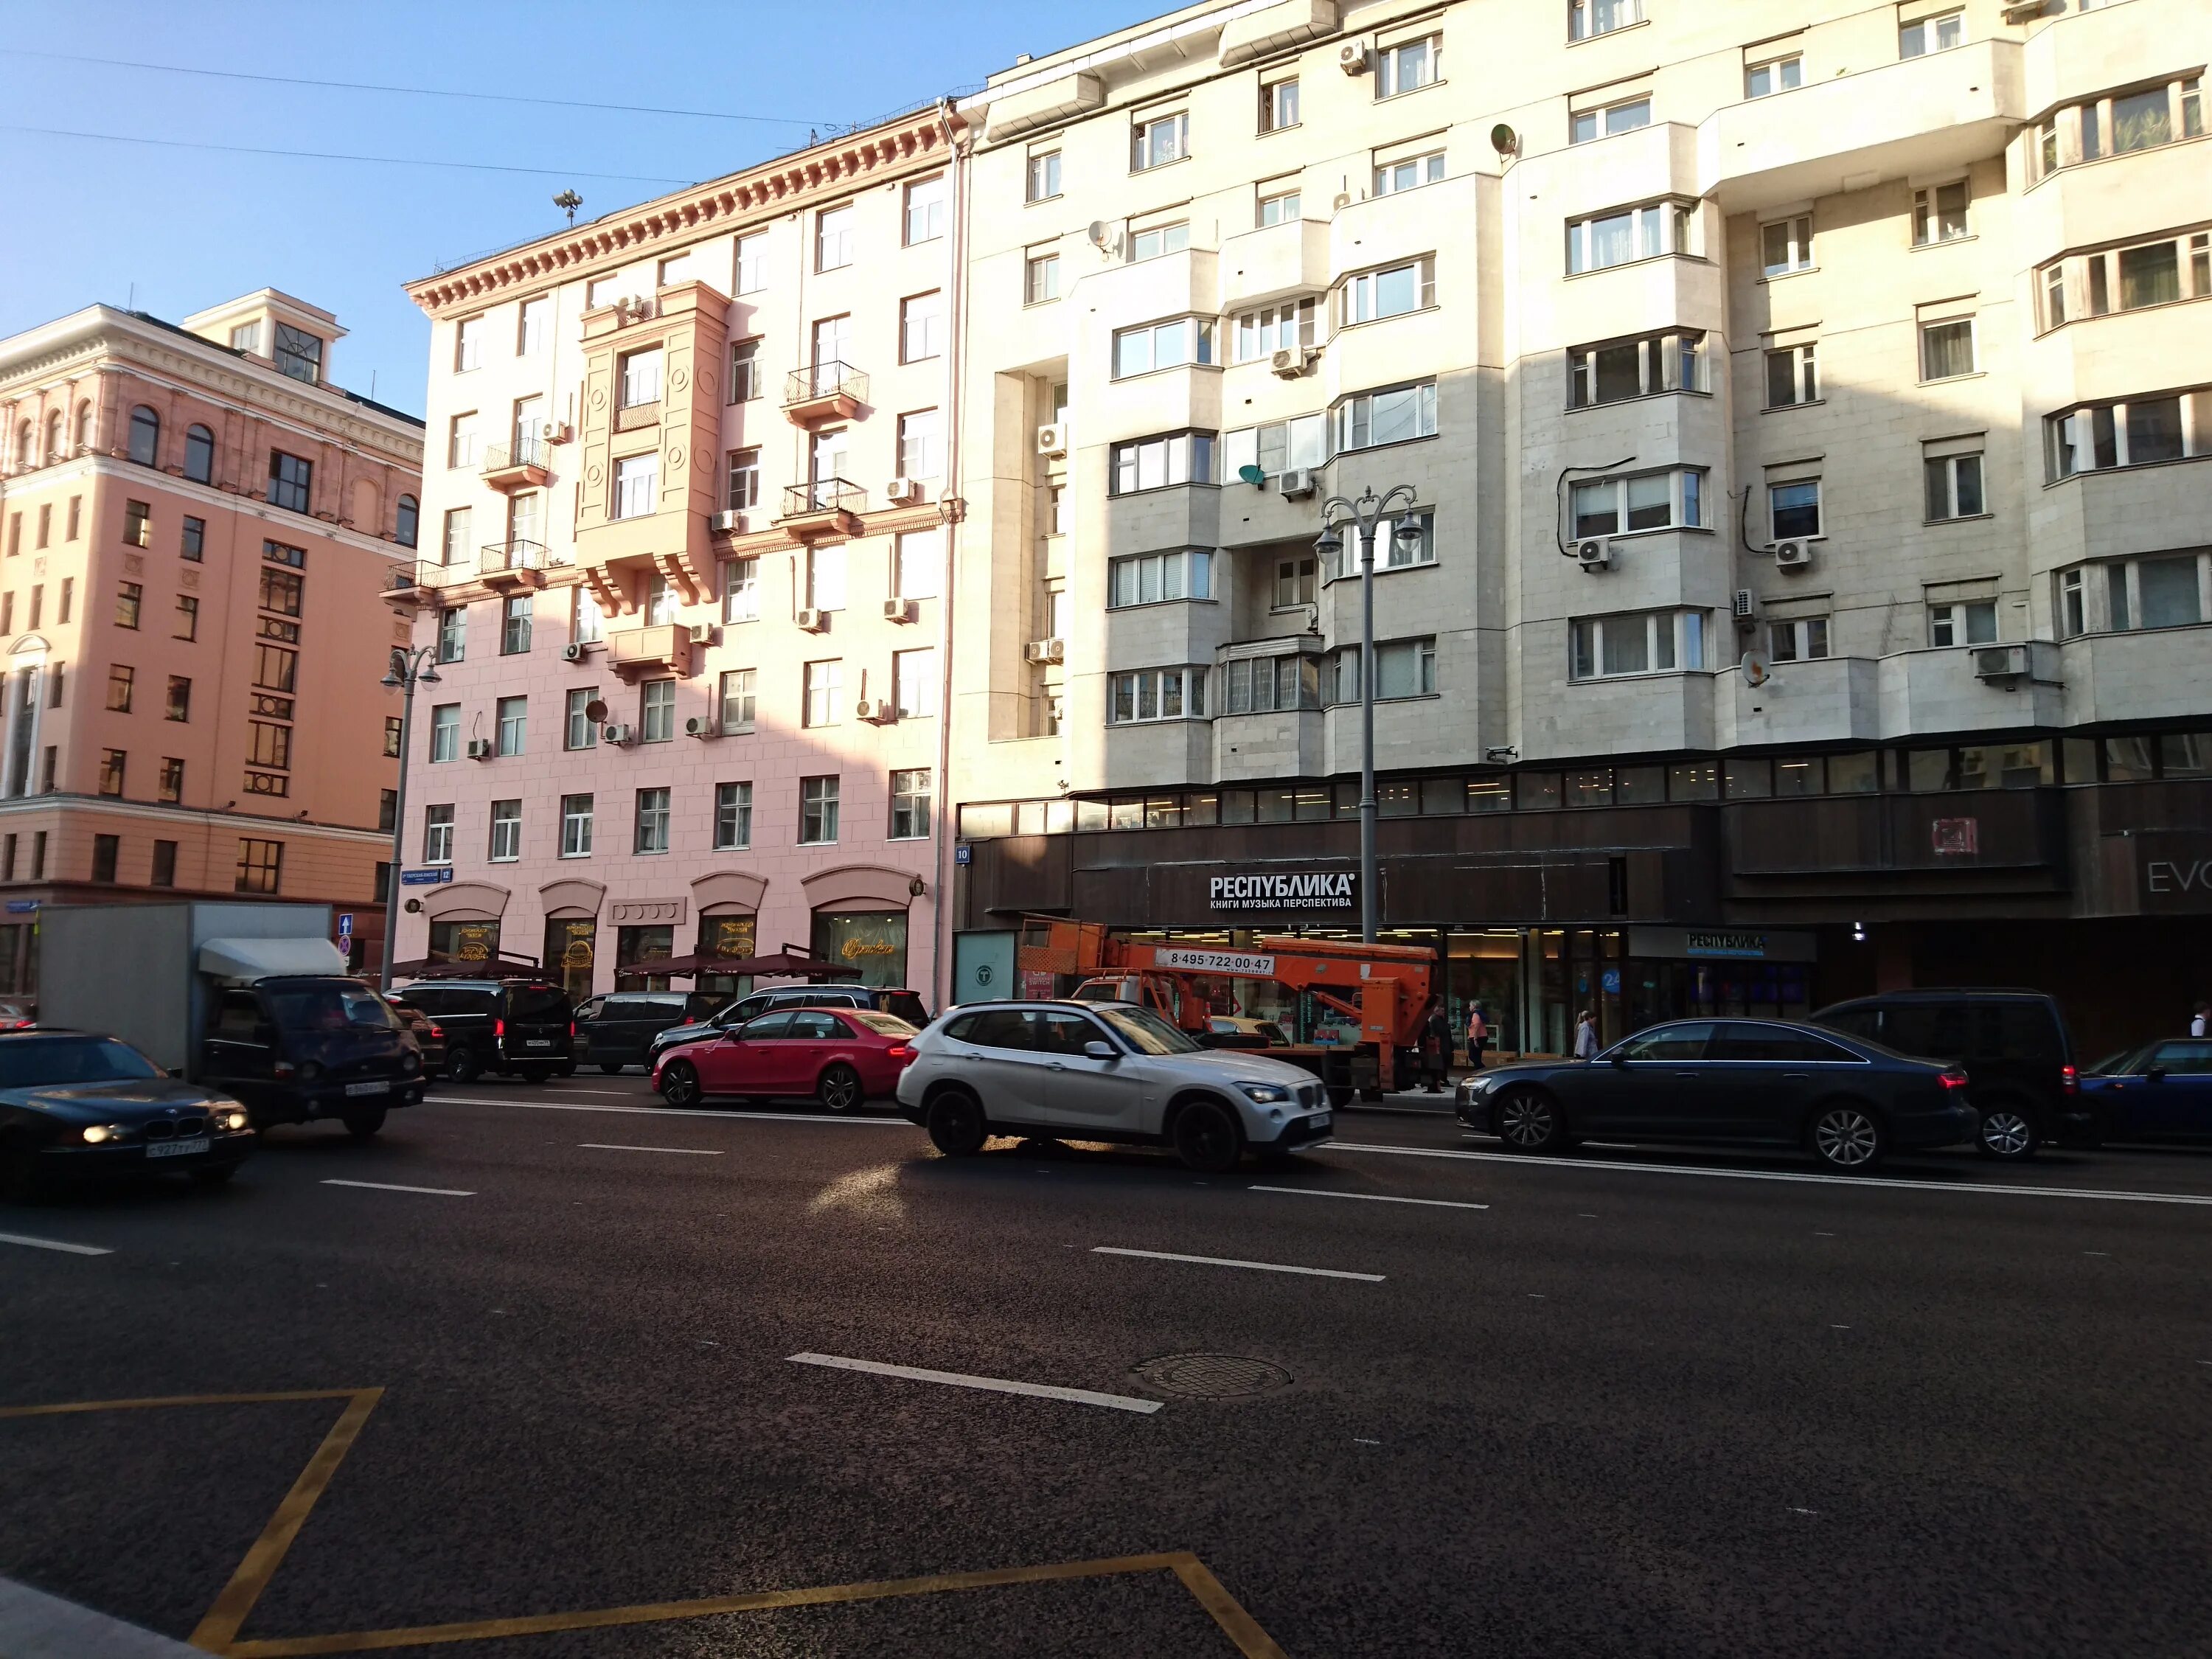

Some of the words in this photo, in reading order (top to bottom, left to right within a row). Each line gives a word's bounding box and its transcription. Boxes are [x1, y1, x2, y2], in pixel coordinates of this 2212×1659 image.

[958, 850, 967, 859] 10
[442, 871, 449, 879] 12
[1210, 873, 1352, 898] РЕСПУБЛИКА
[1210, 900, 1239, 909] КНИГИ
[1242, 899, 1281, 908] МУЗЫКА
[1283, 897, 1352, 908] ПЕРСПЕКТИВА
[1687, 932, 1765, 948] РЕСПУБЛИКА
